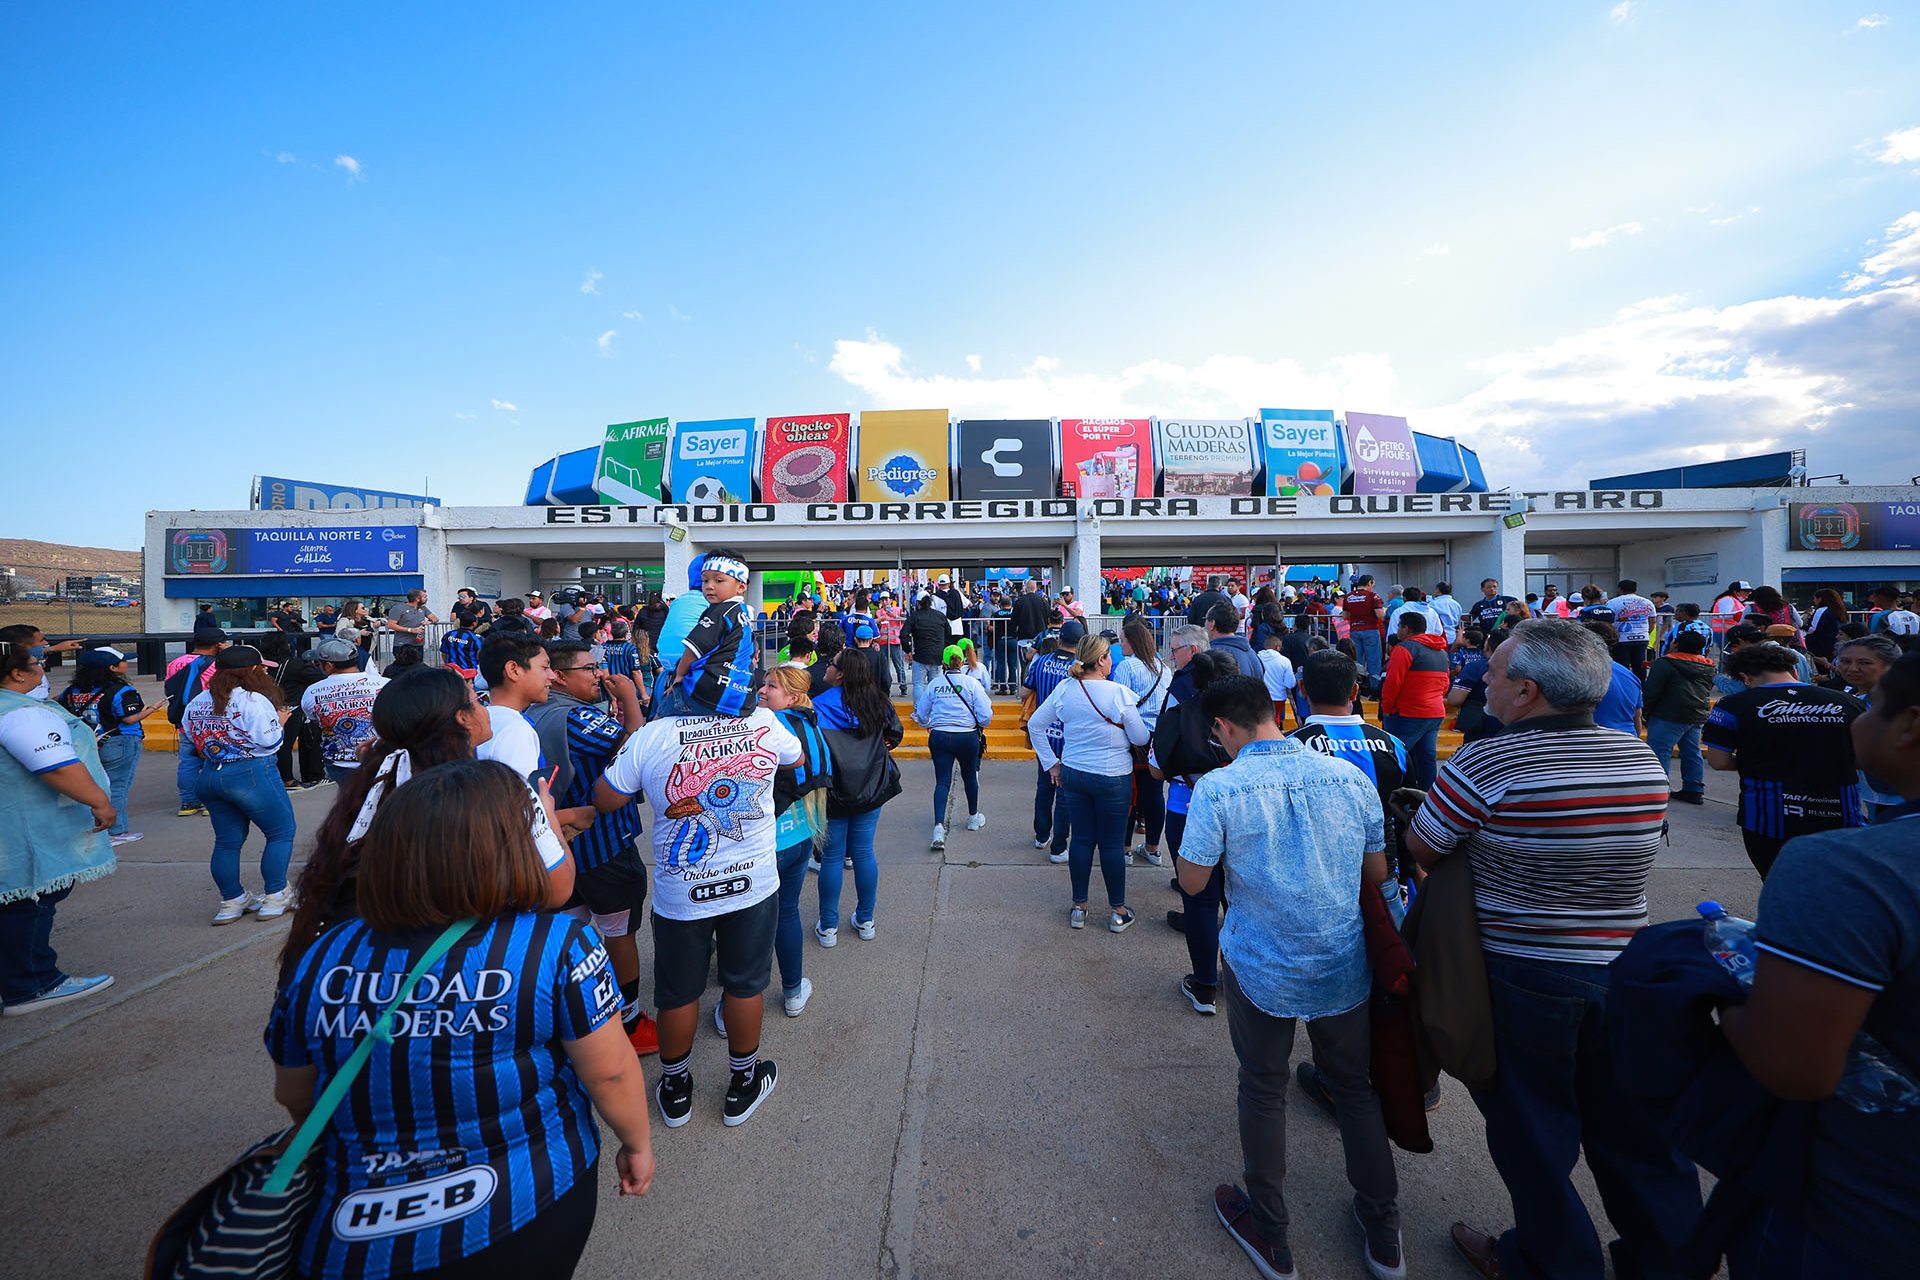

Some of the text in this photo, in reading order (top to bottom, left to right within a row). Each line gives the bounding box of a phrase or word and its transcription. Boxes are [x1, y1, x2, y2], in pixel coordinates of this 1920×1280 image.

[620, 422, 667, 441] AFIRME
[781, 420, 834, 433] Chocko-
[1165, 422, 1244, 439] CIUDAD
[1272, 423, 1328, 445] Sayer
[786, 430, 829, 442] obleas
[686, 435, 740, 455] Sayer
[1167, 439, 1247, 454] MADERAS
[1380, 441, 1405, 451] PETRO
[867, 467, 937, 483] Pedigree
[1363, 467, 1399, 477] Sirviendo
[1379, 477, 1406, 486] destino
[547, 503, 775, 524] ESTADIO
[807, 499, 1197, 521] CORREGIDORA
[1230, 497, 1297, 515] DE
[254, 530, 372, 542] TAQUILLA NORTE 2
[299, 545, 328, 553] SIEMPRE
[294, 552, 332, 565] GALLOS
[1756, 699, 1843, 719] Caliente
[1768, 714, 1845, 724] caliente.mx
[687, 722, 749, 739] PAQUETEXPRESS
[700, 739, 756, 760] AFIRME
[1305, 733, 1389, 756] Corona
[319, 964, 514, 1005] CIUDAD
[313, 1004, 510, 1040] MADERAS
